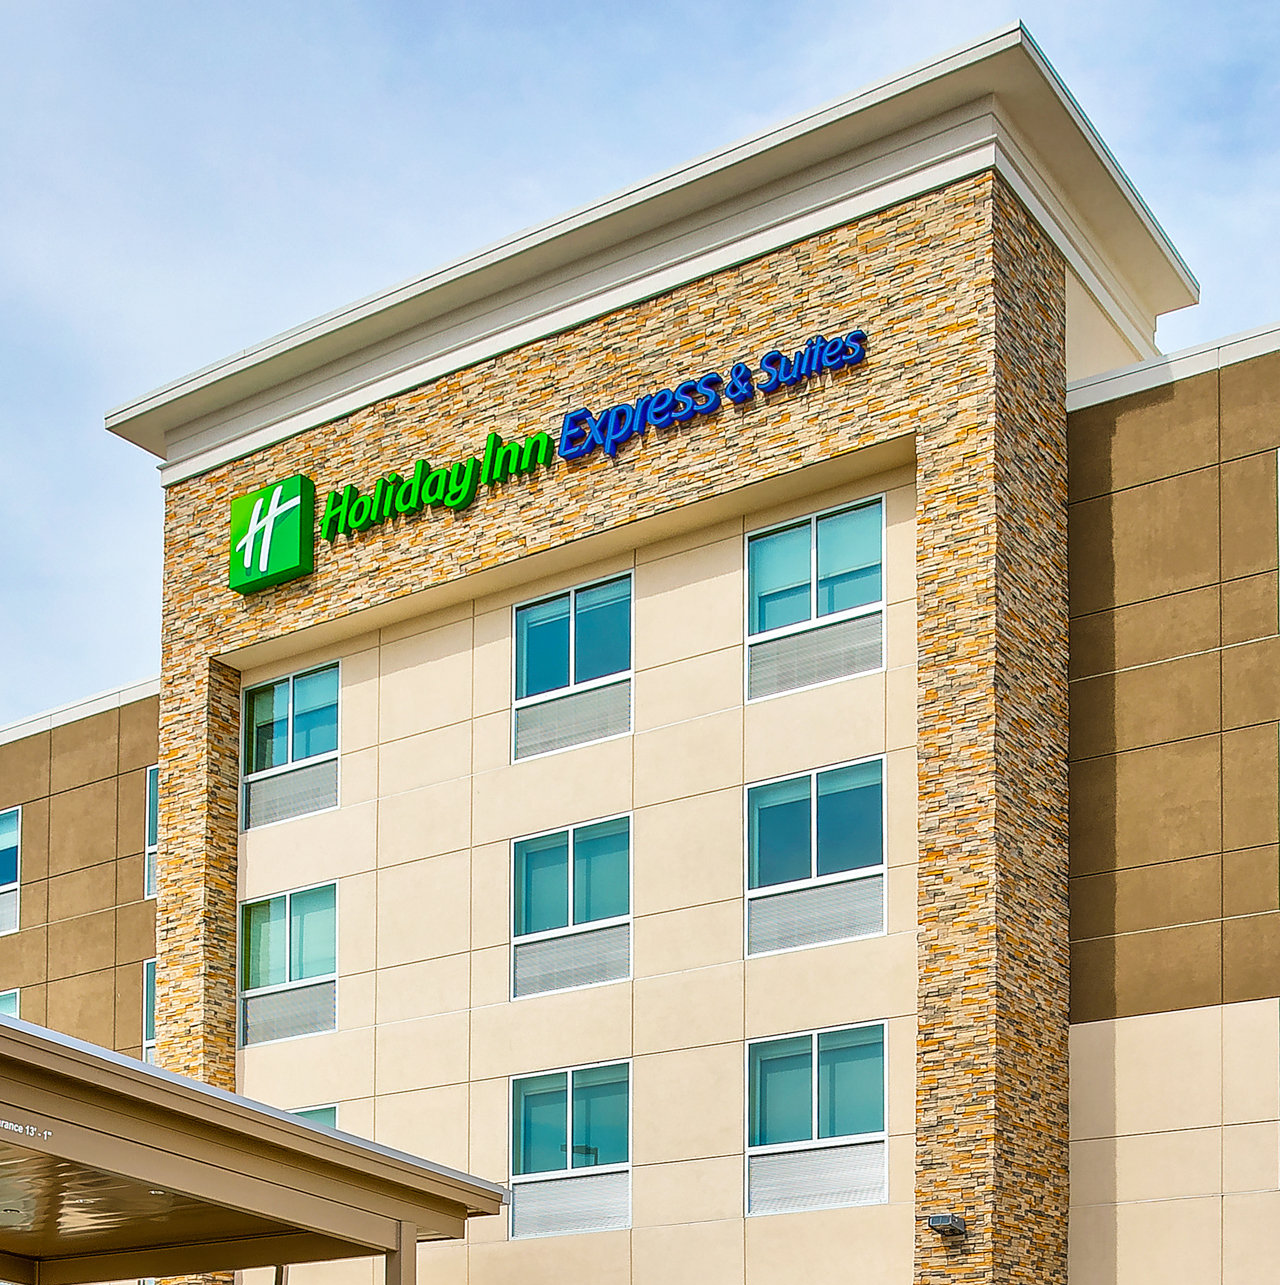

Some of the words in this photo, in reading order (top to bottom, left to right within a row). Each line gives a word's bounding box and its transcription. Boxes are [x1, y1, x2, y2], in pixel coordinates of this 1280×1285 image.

[319, 457, 480, 542] Holiday
[480, 432, 554, 487] Inn
[558, 371, 723, 459] Express
[725, 362, 754, 403] &
[757, 329, 868, 393] Suites
